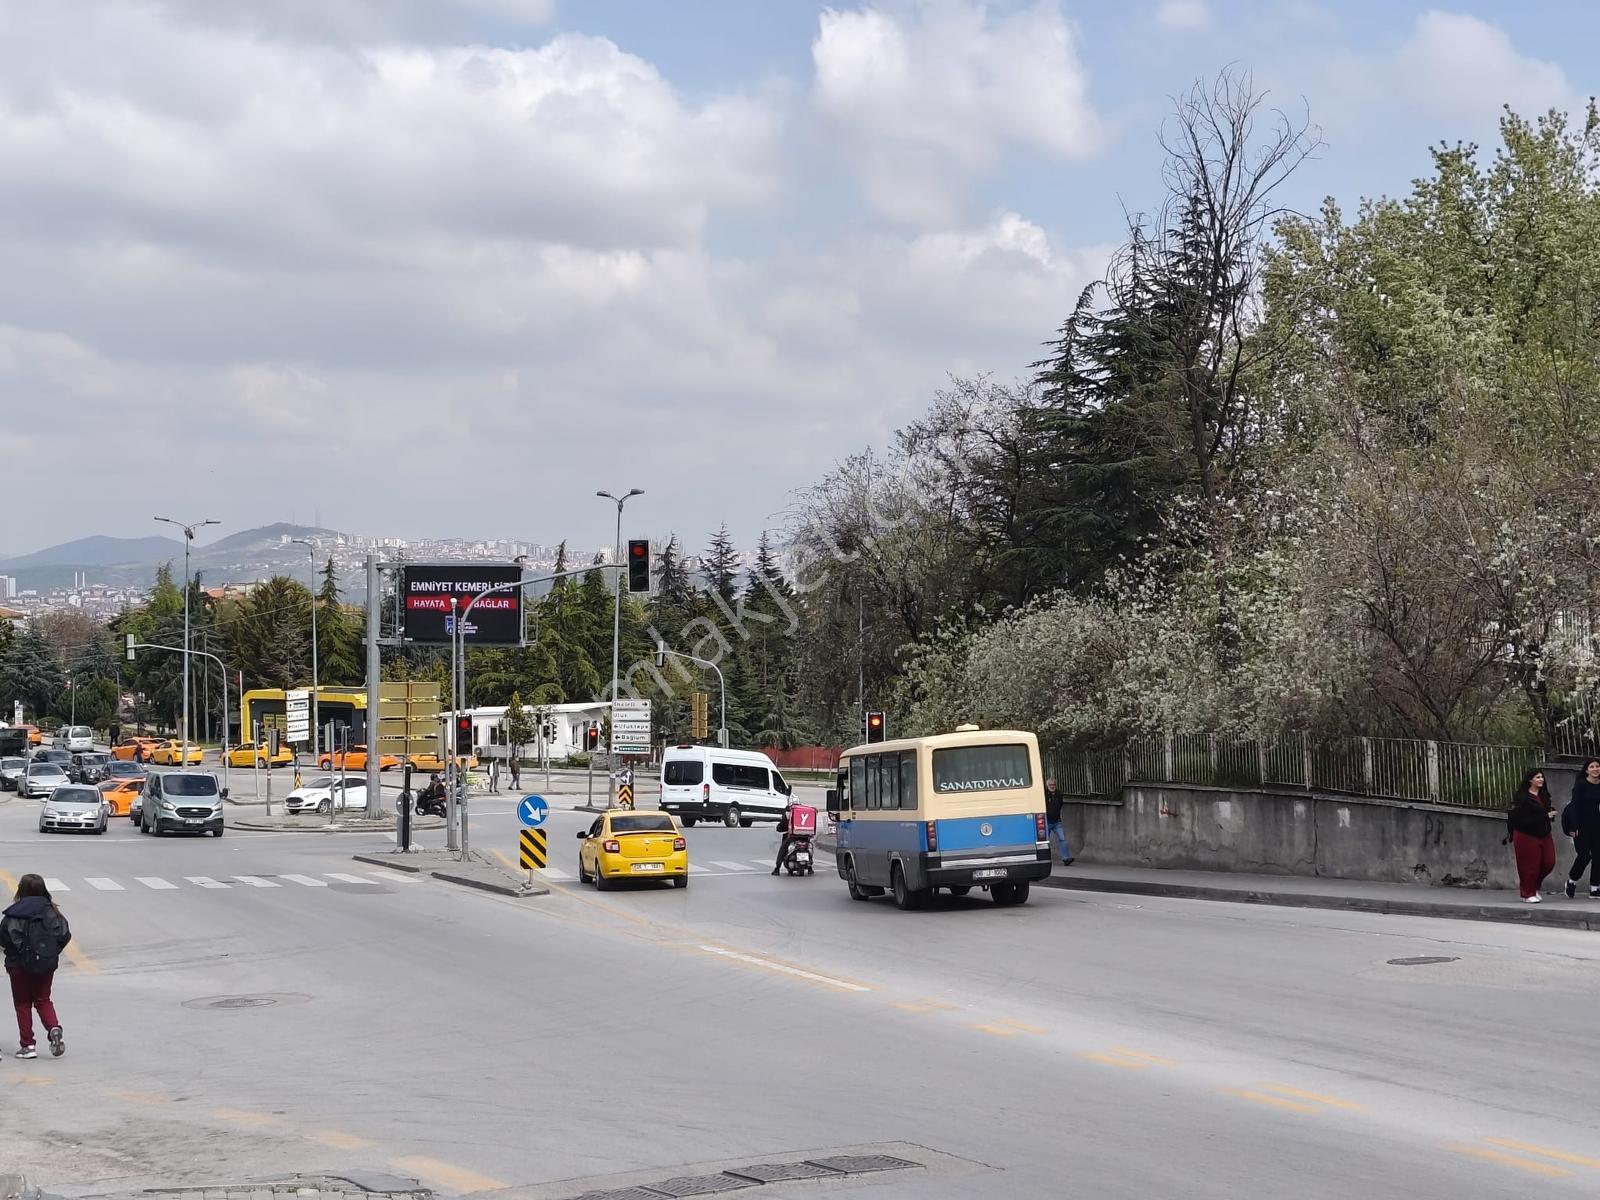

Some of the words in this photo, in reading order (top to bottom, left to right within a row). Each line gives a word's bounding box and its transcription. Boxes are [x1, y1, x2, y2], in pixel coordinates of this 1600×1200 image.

[411, 581, 453, 592] EMNİYET
[455, 581, 492, 592] KEMERİ
[413, 600, 445, 608] HAYATA
[474, 599, 509, 608] BAĞLAR
[940, 777, 1024, 791] SANATORYUM
